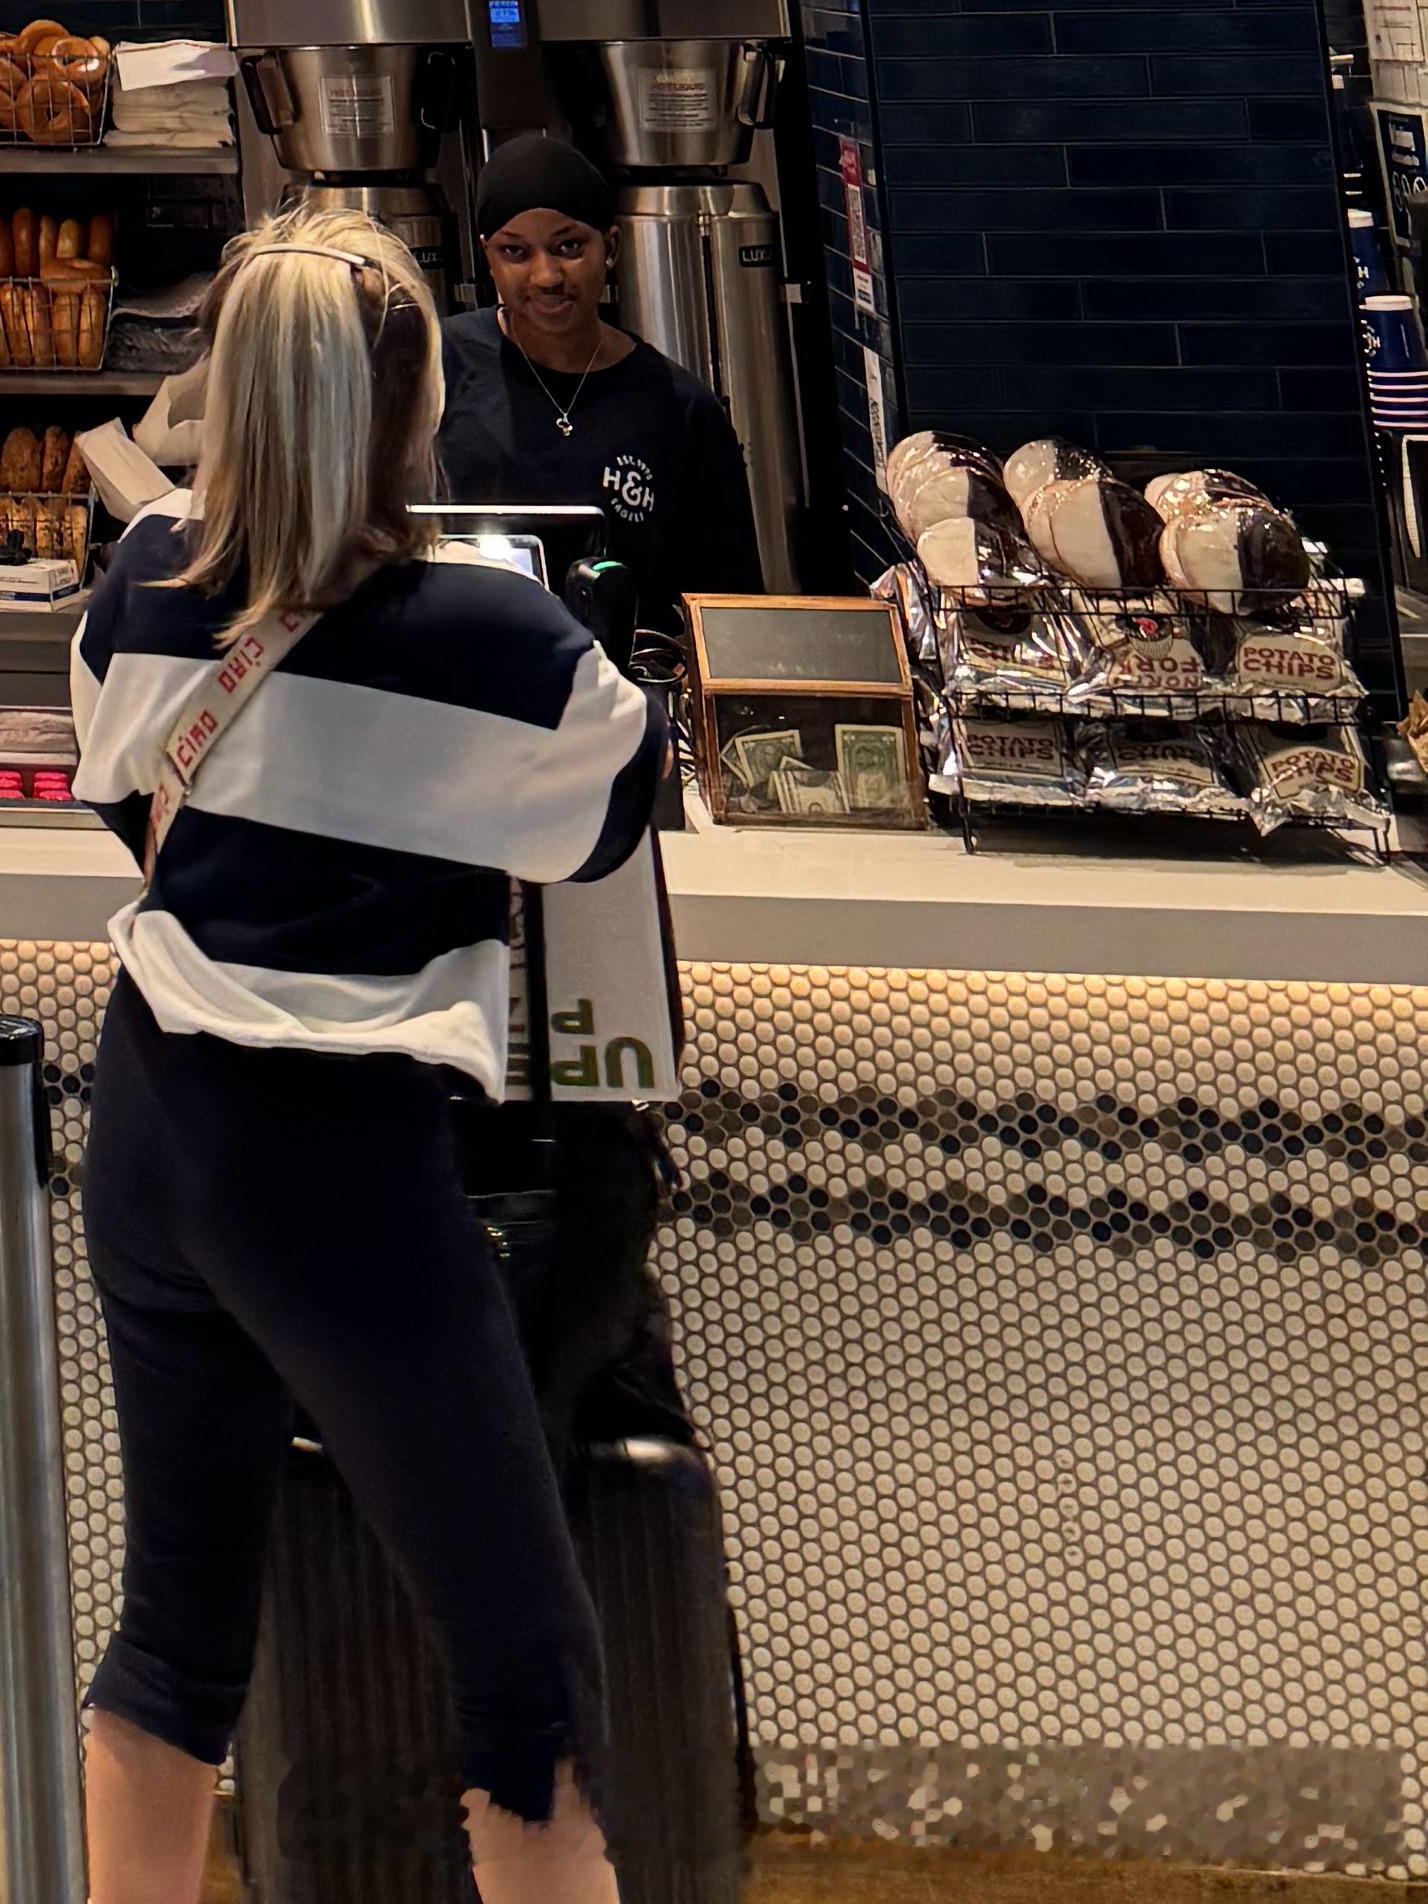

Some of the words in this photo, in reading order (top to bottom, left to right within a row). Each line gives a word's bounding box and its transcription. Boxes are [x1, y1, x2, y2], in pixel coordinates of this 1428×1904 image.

[603, 466, 654, 512] H&H
[1244, 647, 1336, 666] POTATO
[1244, 659, 1334, 680] CHIPS
[176, 709, 218, 768] CIAO
[969, 745, 1054, 761] CHIPS
[1271, 751, 1355, 772] POTATO
